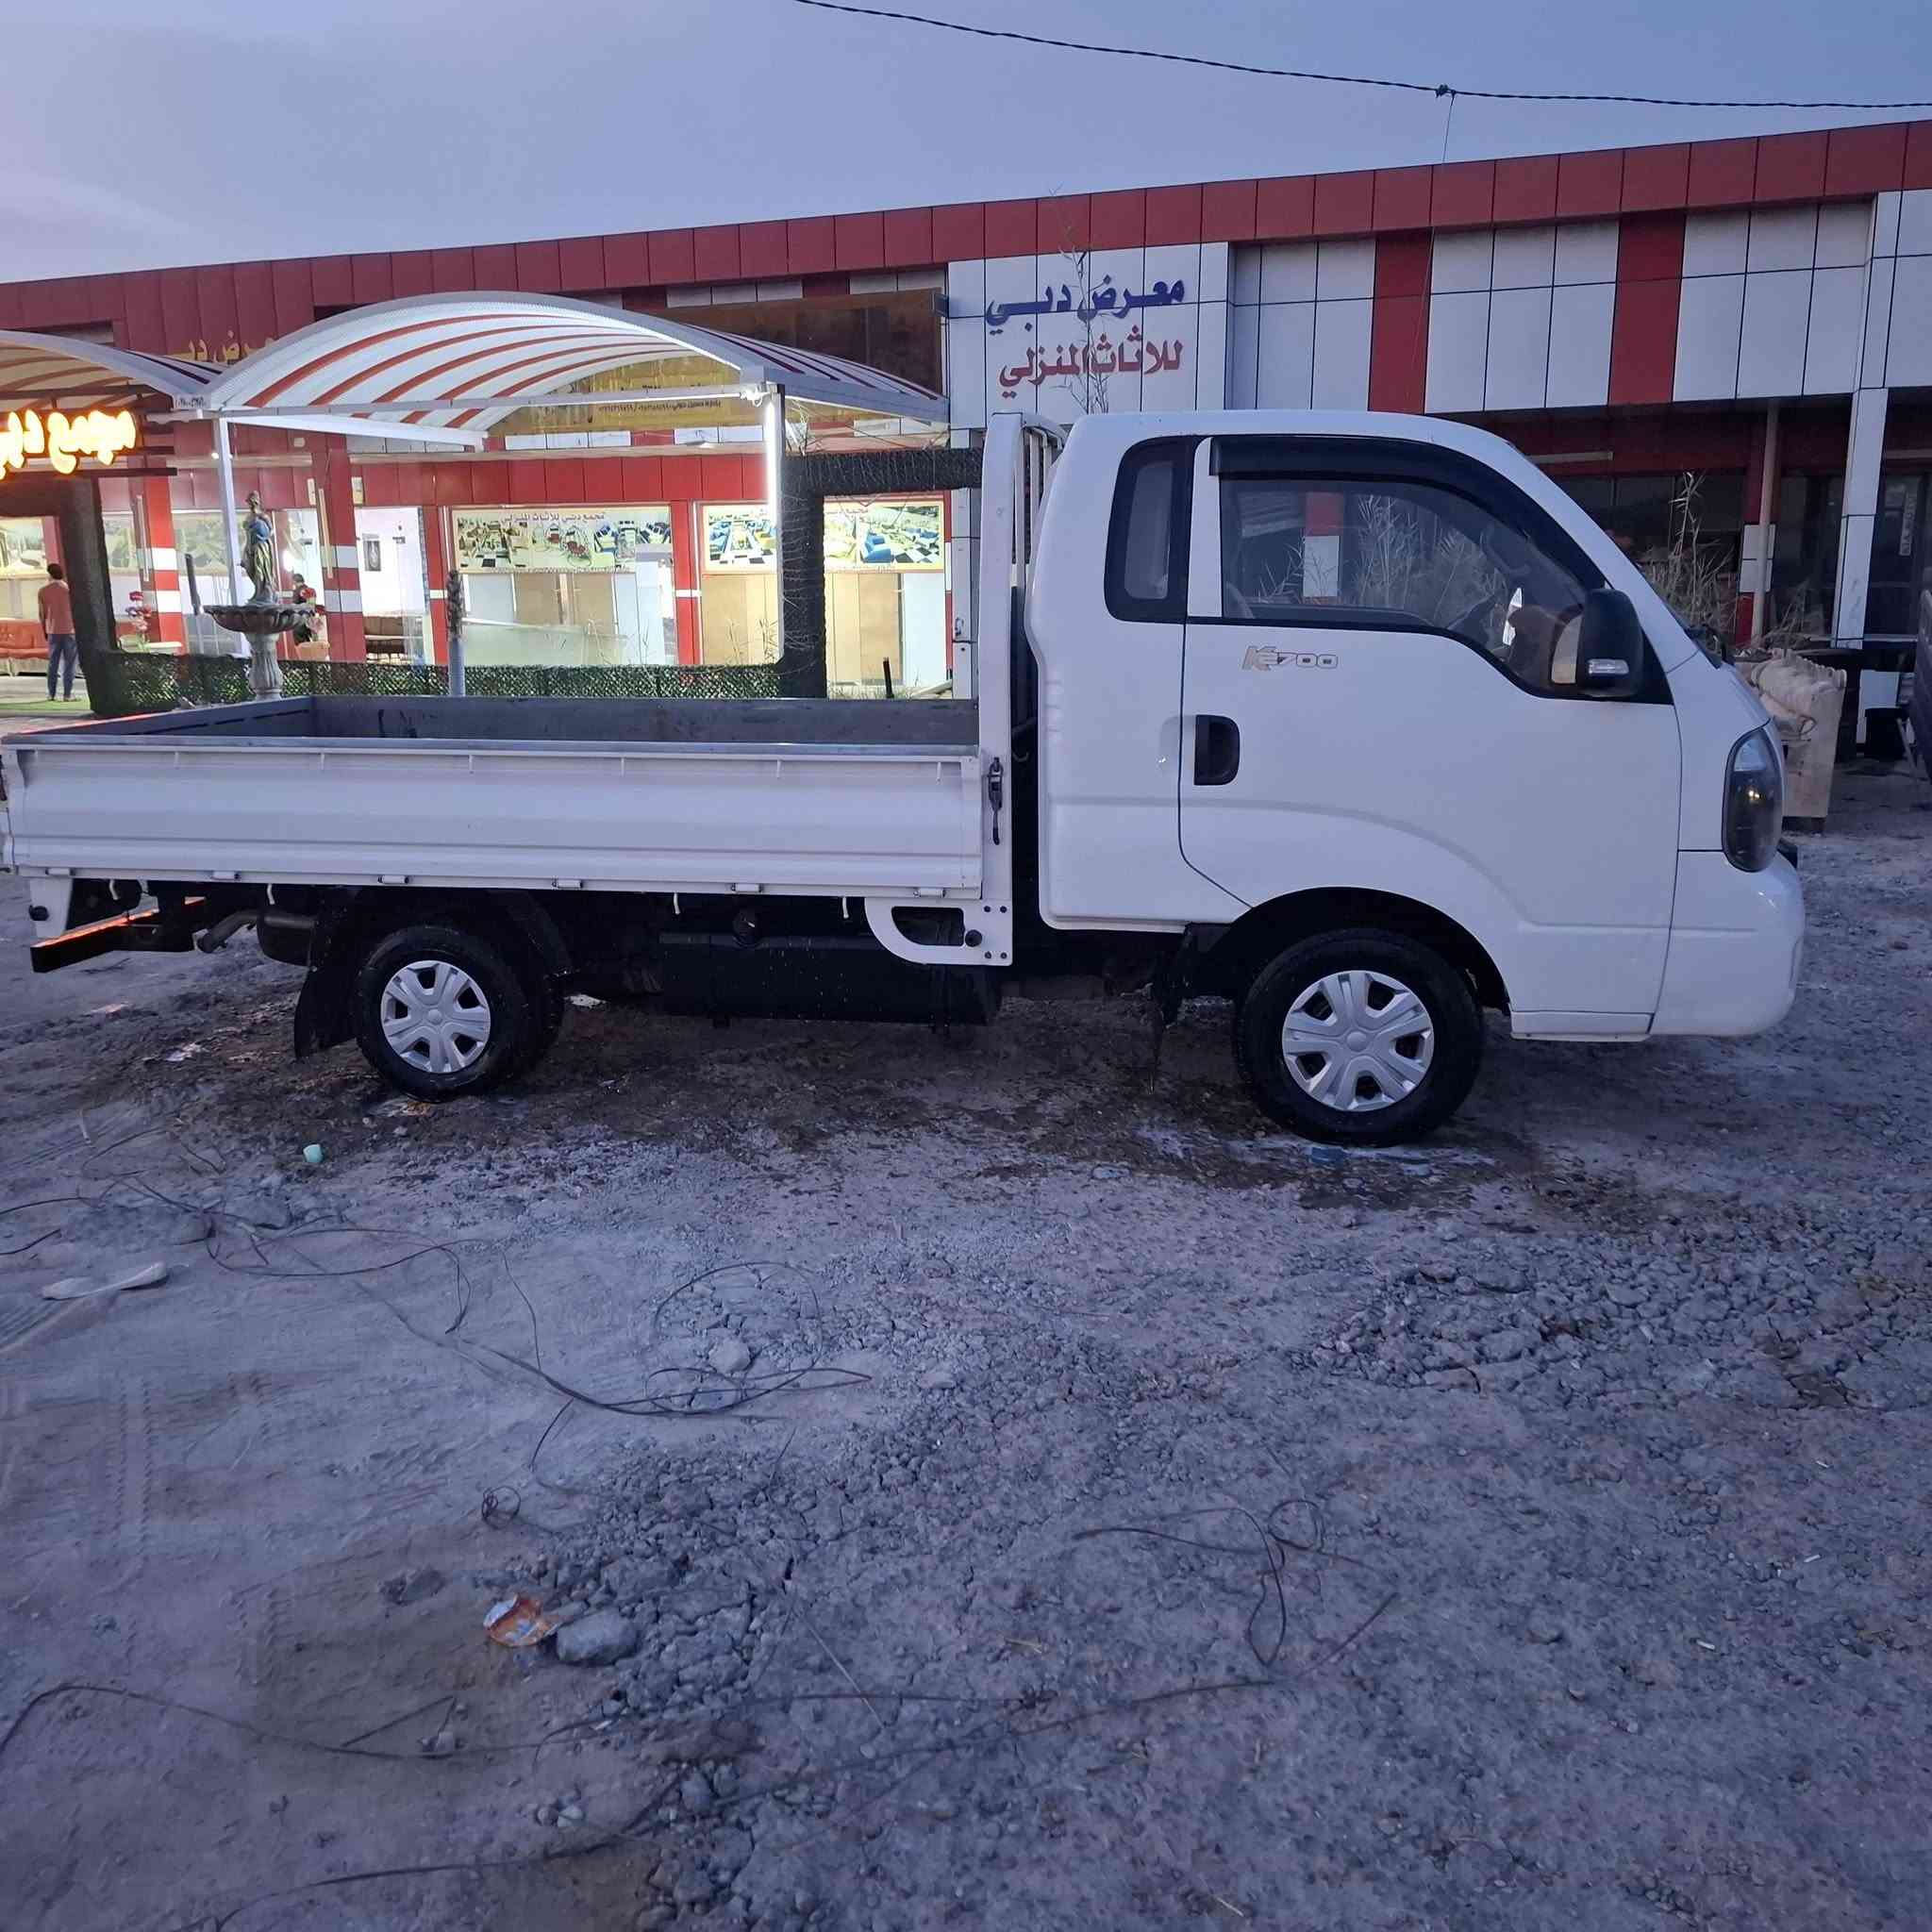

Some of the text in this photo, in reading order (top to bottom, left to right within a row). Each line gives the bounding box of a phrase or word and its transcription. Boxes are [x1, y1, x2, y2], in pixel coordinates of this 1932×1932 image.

[987, 274, 1185, 336] معرض دبي
[999, 341, 1089, 398] المنزلي
